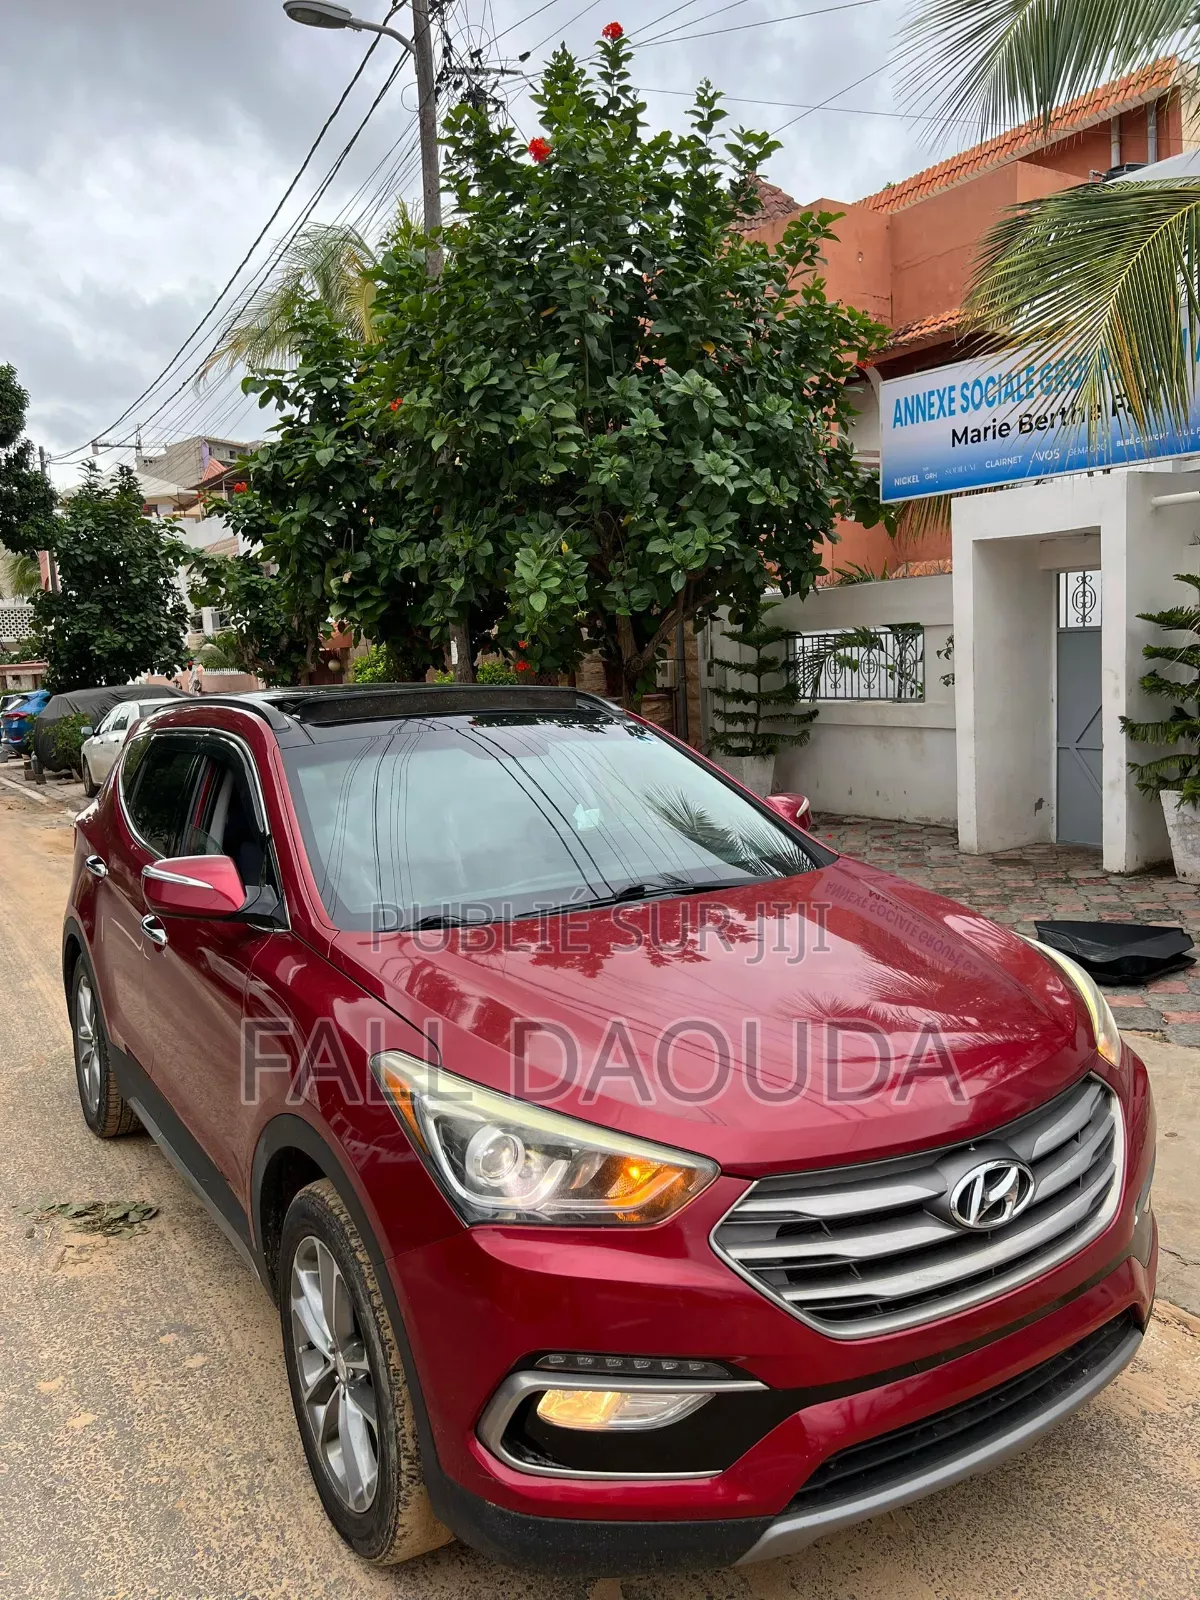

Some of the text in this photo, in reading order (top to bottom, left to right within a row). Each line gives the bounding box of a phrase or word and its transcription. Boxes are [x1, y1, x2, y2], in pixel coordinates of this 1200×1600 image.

[893, 384, 956, 429] ANNEXE
[960, 366, 1035, 414] SOCIALE
[951, 418, 1011, 448] Marie
[985, 455, 1023, 469] CLAIRNET
[894, 474, 920, 487] NICKEL
